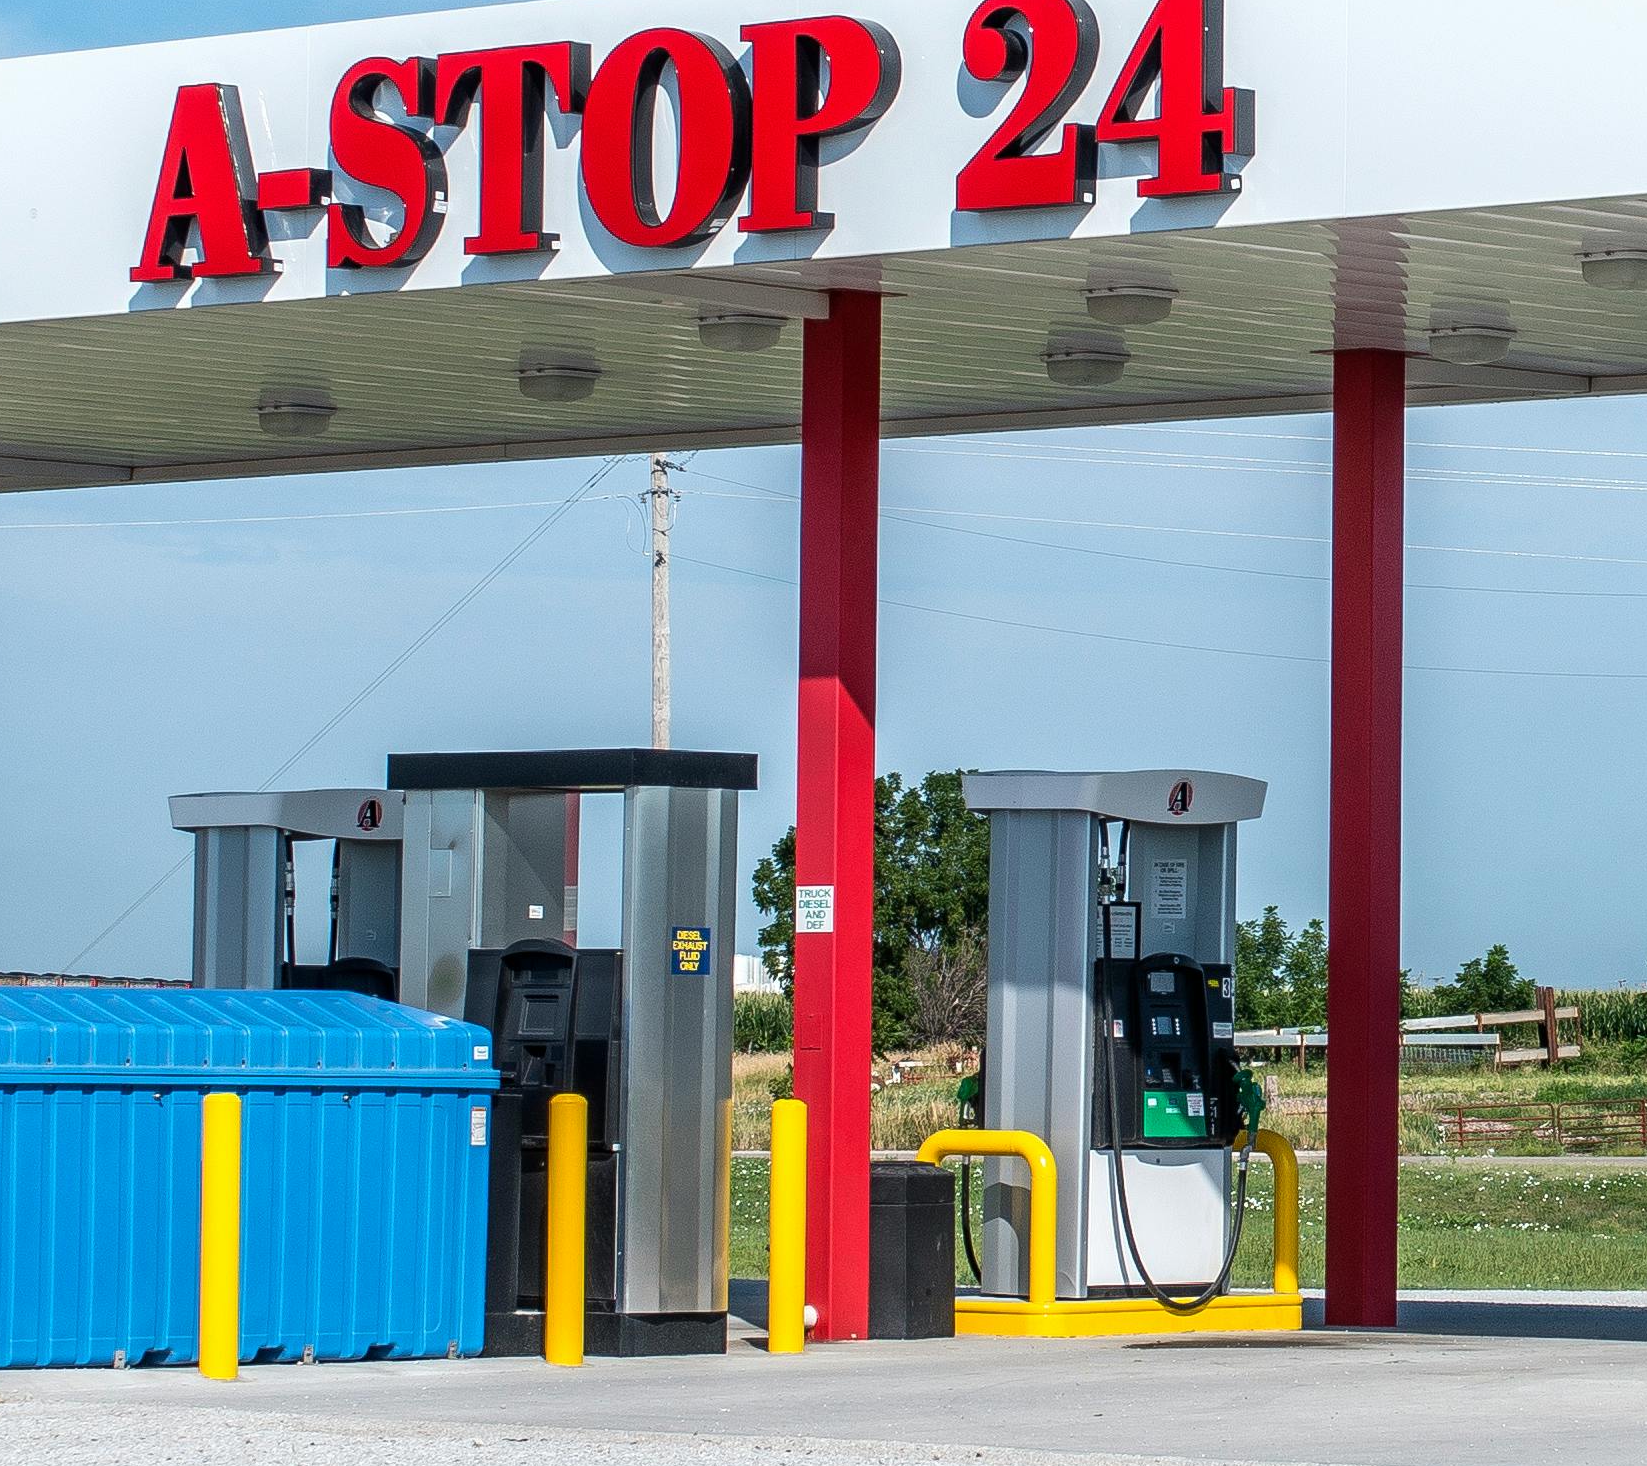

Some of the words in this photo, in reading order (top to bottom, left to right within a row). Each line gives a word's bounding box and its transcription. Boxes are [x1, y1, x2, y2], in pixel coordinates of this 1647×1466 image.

[129, 14, 894, 283] A-STOP
[798, 888, 832, 898] TRUCK
[798, 899, 832, 909] DIESEL
[805, 910, 826, 920] AND
[806, 920, 825, 930] DEF
[677, 930, 702, 940] DIESEL
[672, 940, 708, 951] EXHAUST
[679, 951, 700, 961] FLUID
[679, 961, 699, 971] ONLY
[1223, 979, 1231, 997] 3
